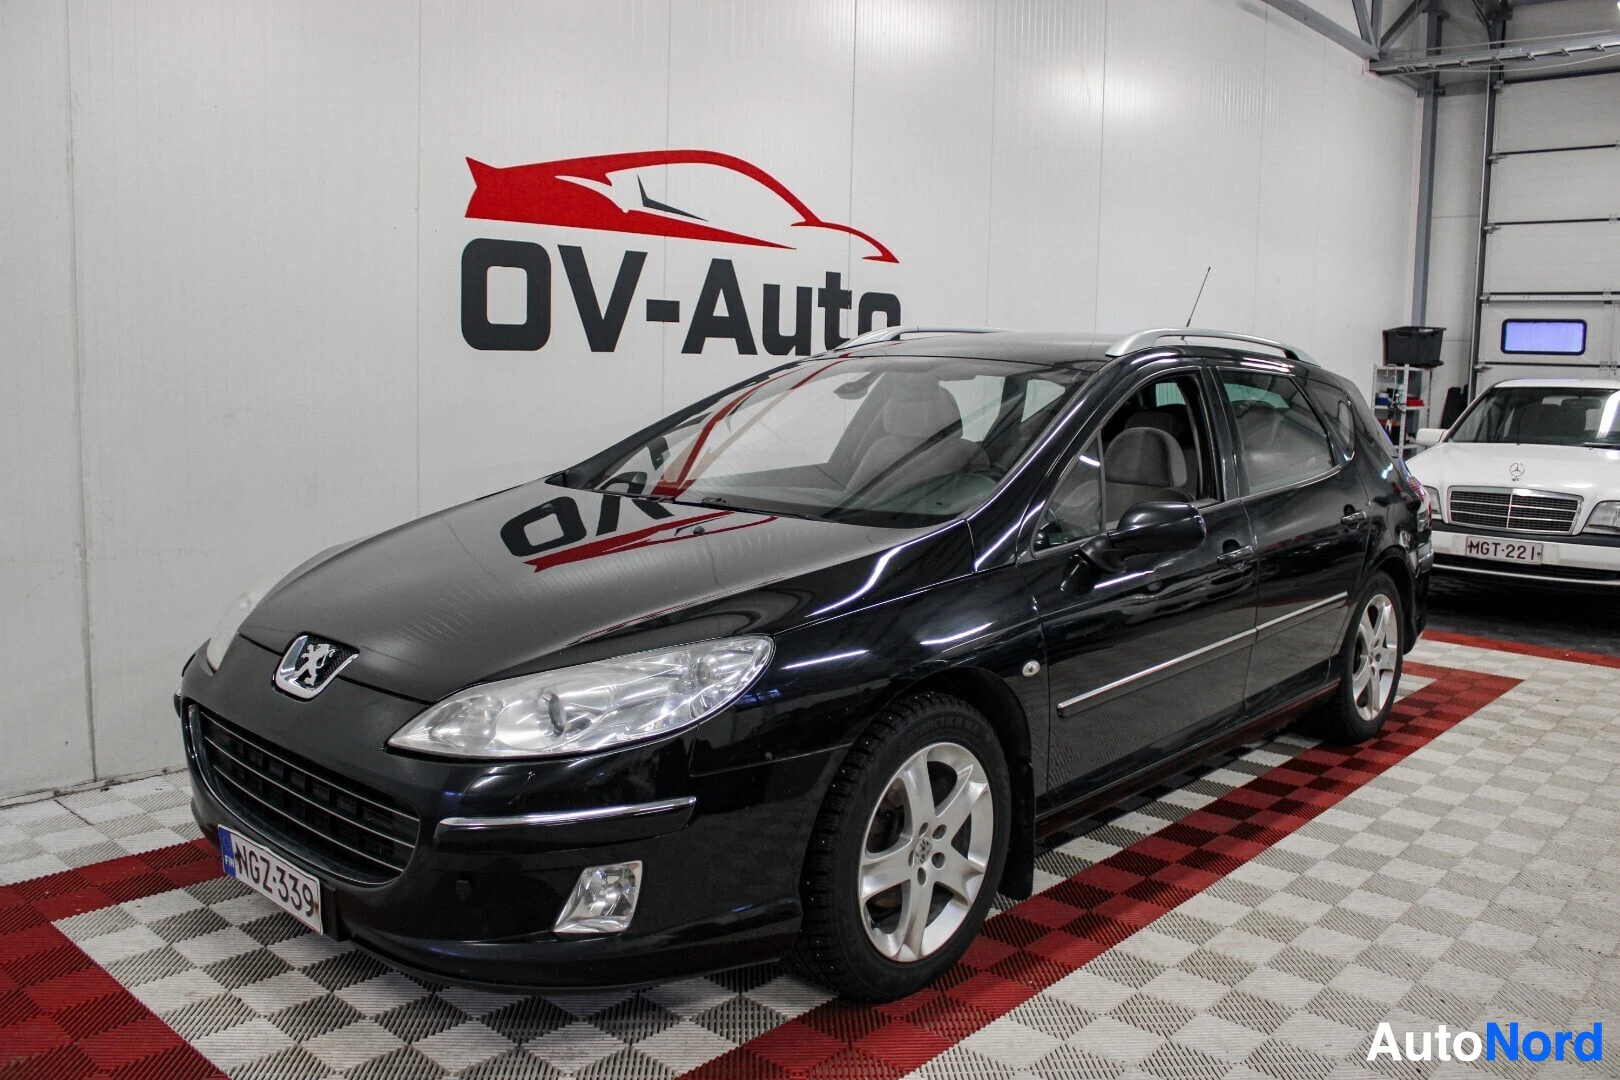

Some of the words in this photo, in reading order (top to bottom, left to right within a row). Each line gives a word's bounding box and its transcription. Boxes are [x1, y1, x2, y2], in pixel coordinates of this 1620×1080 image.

[461, 237, 902, 356] OV-Auto
[1467, 541, 1535, 561] MGT-221
[235, 841, 315, 917] NGZ-339
